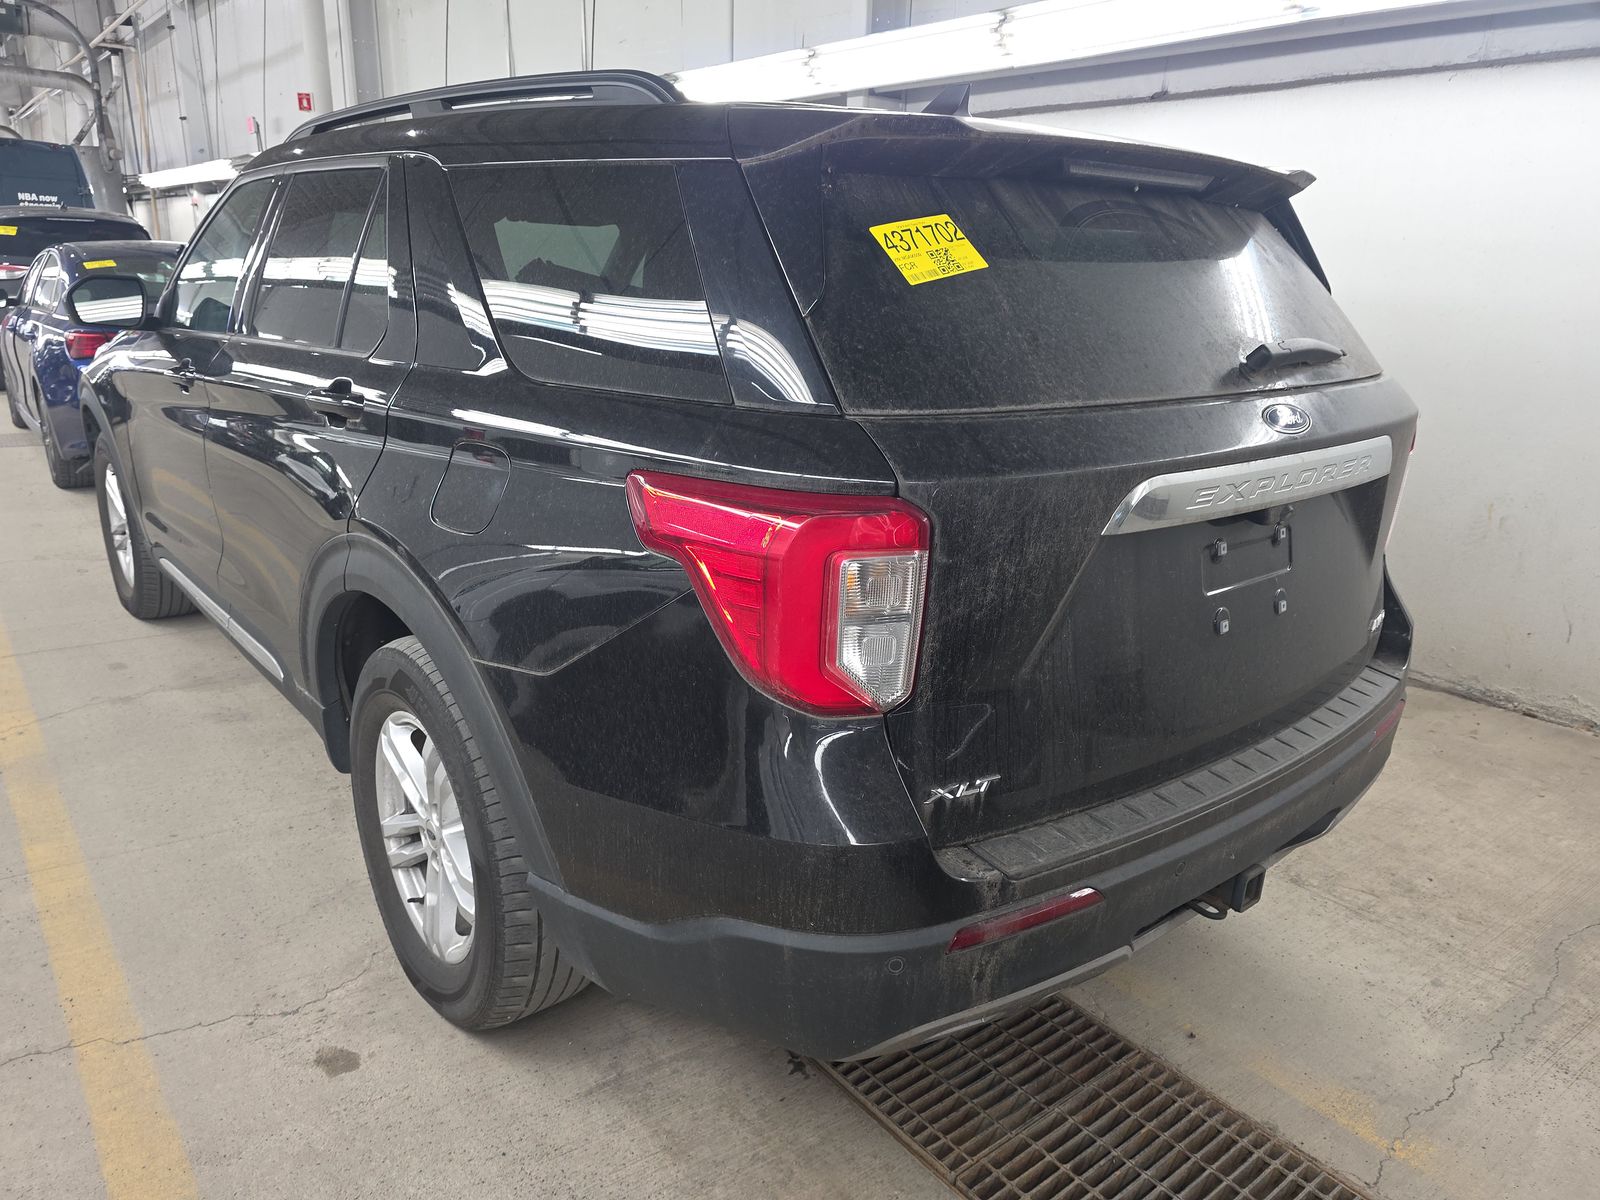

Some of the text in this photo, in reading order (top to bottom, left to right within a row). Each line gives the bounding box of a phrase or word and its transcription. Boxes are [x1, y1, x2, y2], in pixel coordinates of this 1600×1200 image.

[17, 192, 38, 201] NBA
[883, 221, 965, 253] 4371702
[899, 261, 918, 272] FCR
[1186, 455, 1372, 509] EXPLORER
[923, 774, 1001, 804] XLT
